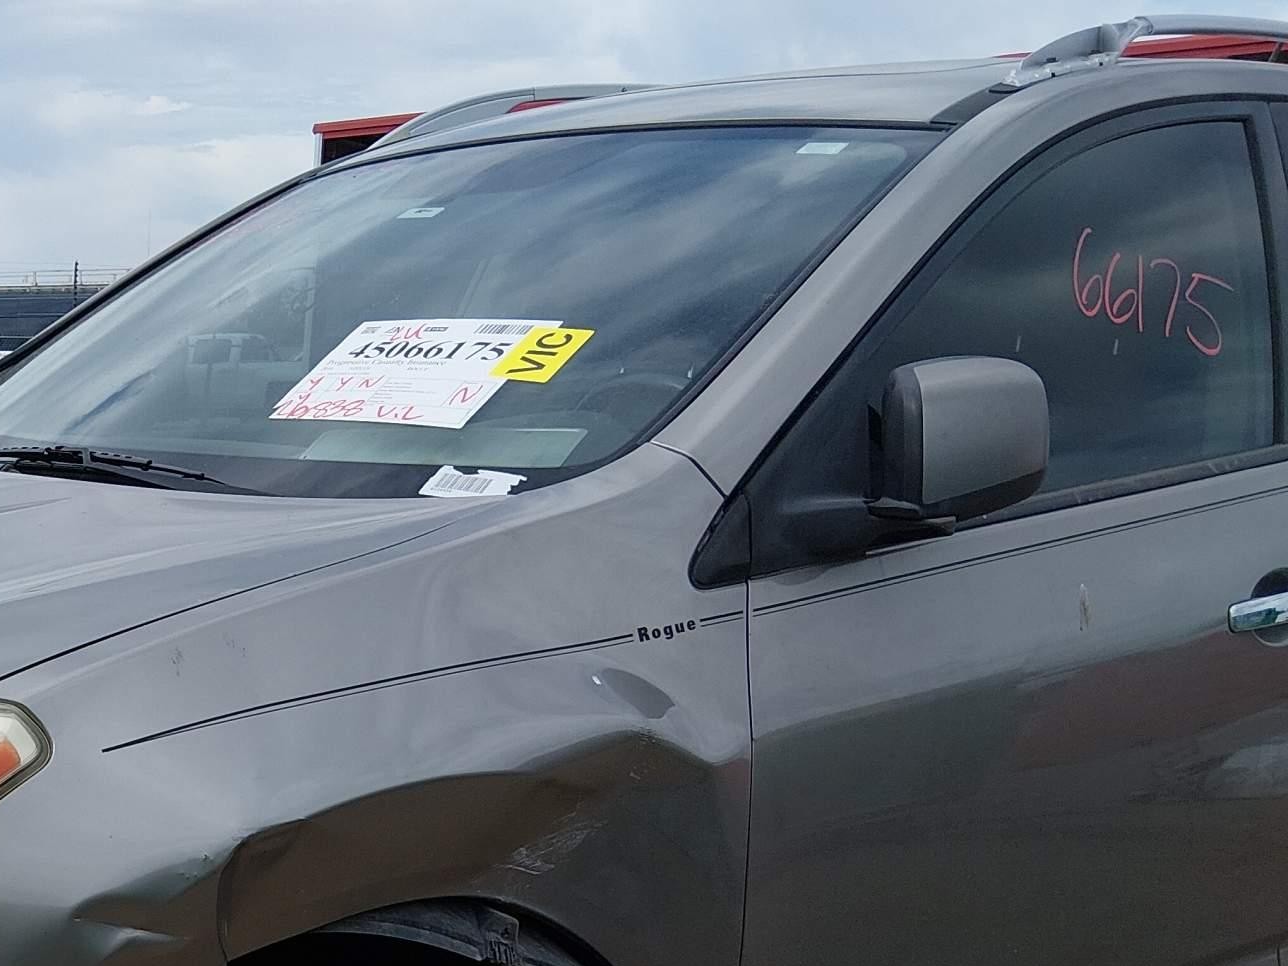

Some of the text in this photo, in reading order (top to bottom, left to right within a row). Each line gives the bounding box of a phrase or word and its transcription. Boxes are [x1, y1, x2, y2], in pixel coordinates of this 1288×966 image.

[1073, 227, 1235, 356] 66175
[349, 340, 513, 361] 45066175
[505, 332, 573, 375] VIC
[637, 619, 697, 642] Rogue
